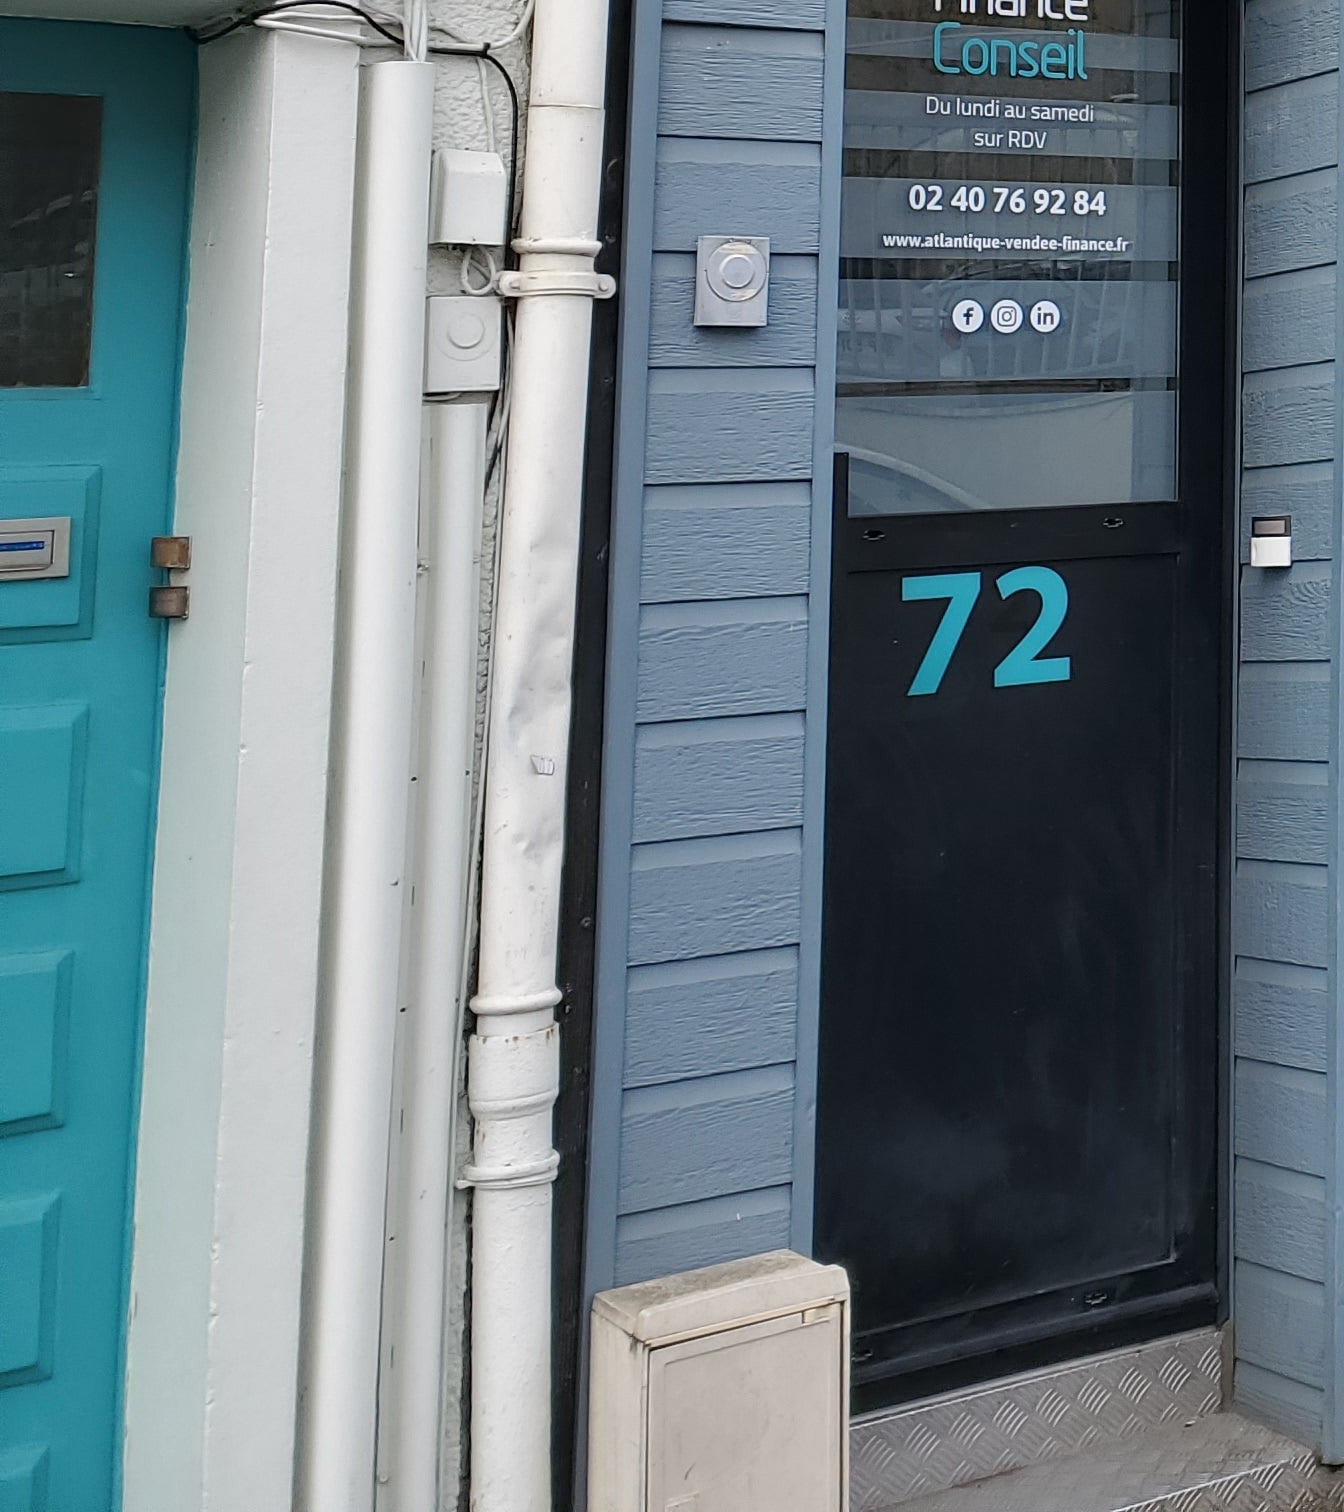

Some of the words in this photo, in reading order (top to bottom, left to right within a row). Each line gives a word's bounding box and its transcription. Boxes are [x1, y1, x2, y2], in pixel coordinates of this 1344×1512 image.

[933, 21, 1088, 80] Conseil
[925, 96, 951, 116] Du
[956, 96, 1000, 118] lundi
[1004, 103, 1026, 119] au
[1030, 105, 1095, 123] samedi
[973, 133, 1005, 148] sur
[1007, 131, 1048, 149] RDV
[908, 184, 943, 211] 02
[950, 186, 986, 213] 40
[992, 187, 1026, 214] 76
[1033, 189, 1066, 215] 92
[1073, 190, 1107, 216] 84
[882, 232, 1131, 253] www.atlantique-vendee-finance.fr
[901, 565, 1071, 697] 72
